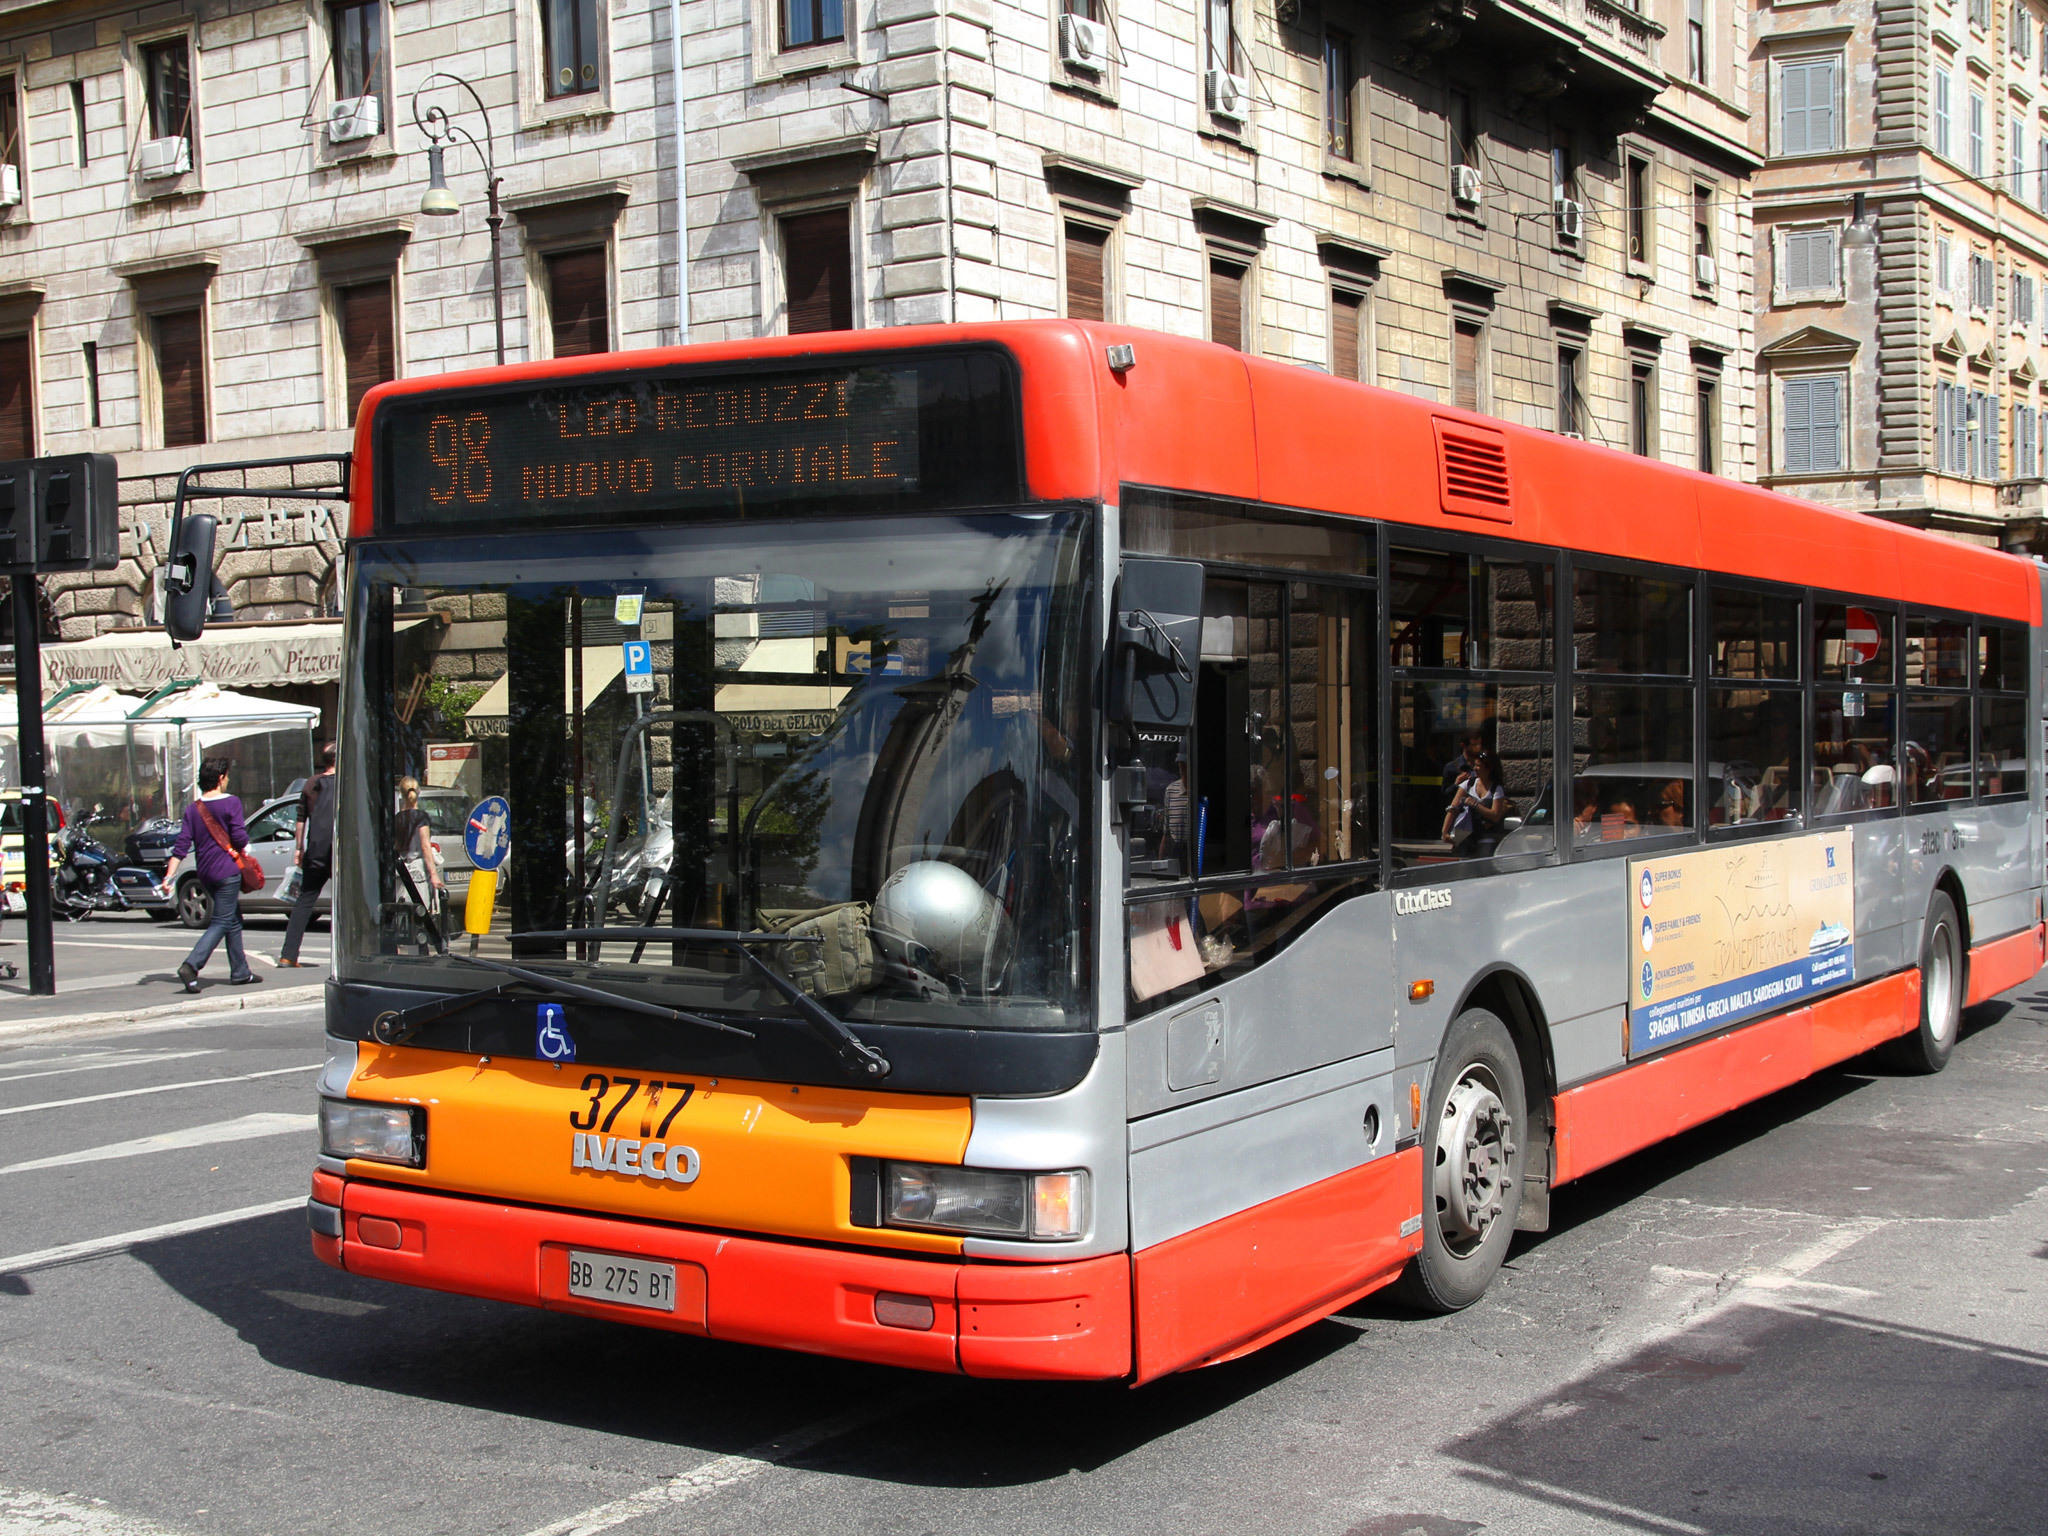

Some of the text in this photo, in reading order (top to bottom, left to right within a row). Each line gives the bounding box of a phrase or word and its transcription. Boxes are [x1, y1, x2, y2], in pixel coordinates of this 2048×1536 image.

[560, 381, 848, 438] LGO REDUZZI
[429, 411, 492, 505] 98
[521, 440, 899, 500] NUOVO CORVIALE
[49, 660, 122, 681] Ristorante
[628, 645, 645, 671] P
[763, 718, 785, 730] DEL
[1395, 888, 1452, 915] CityClass
[1649, 973, 1803, 1040] SPAGNA TUNISIA GRECIA MALTA SARDEGNA SICILIA
[569, 1073, 695, 1139] 3717
[573, 1132, 700, 1183] IVECO
[570, 1260, 672, 1301] BB 275 BT
